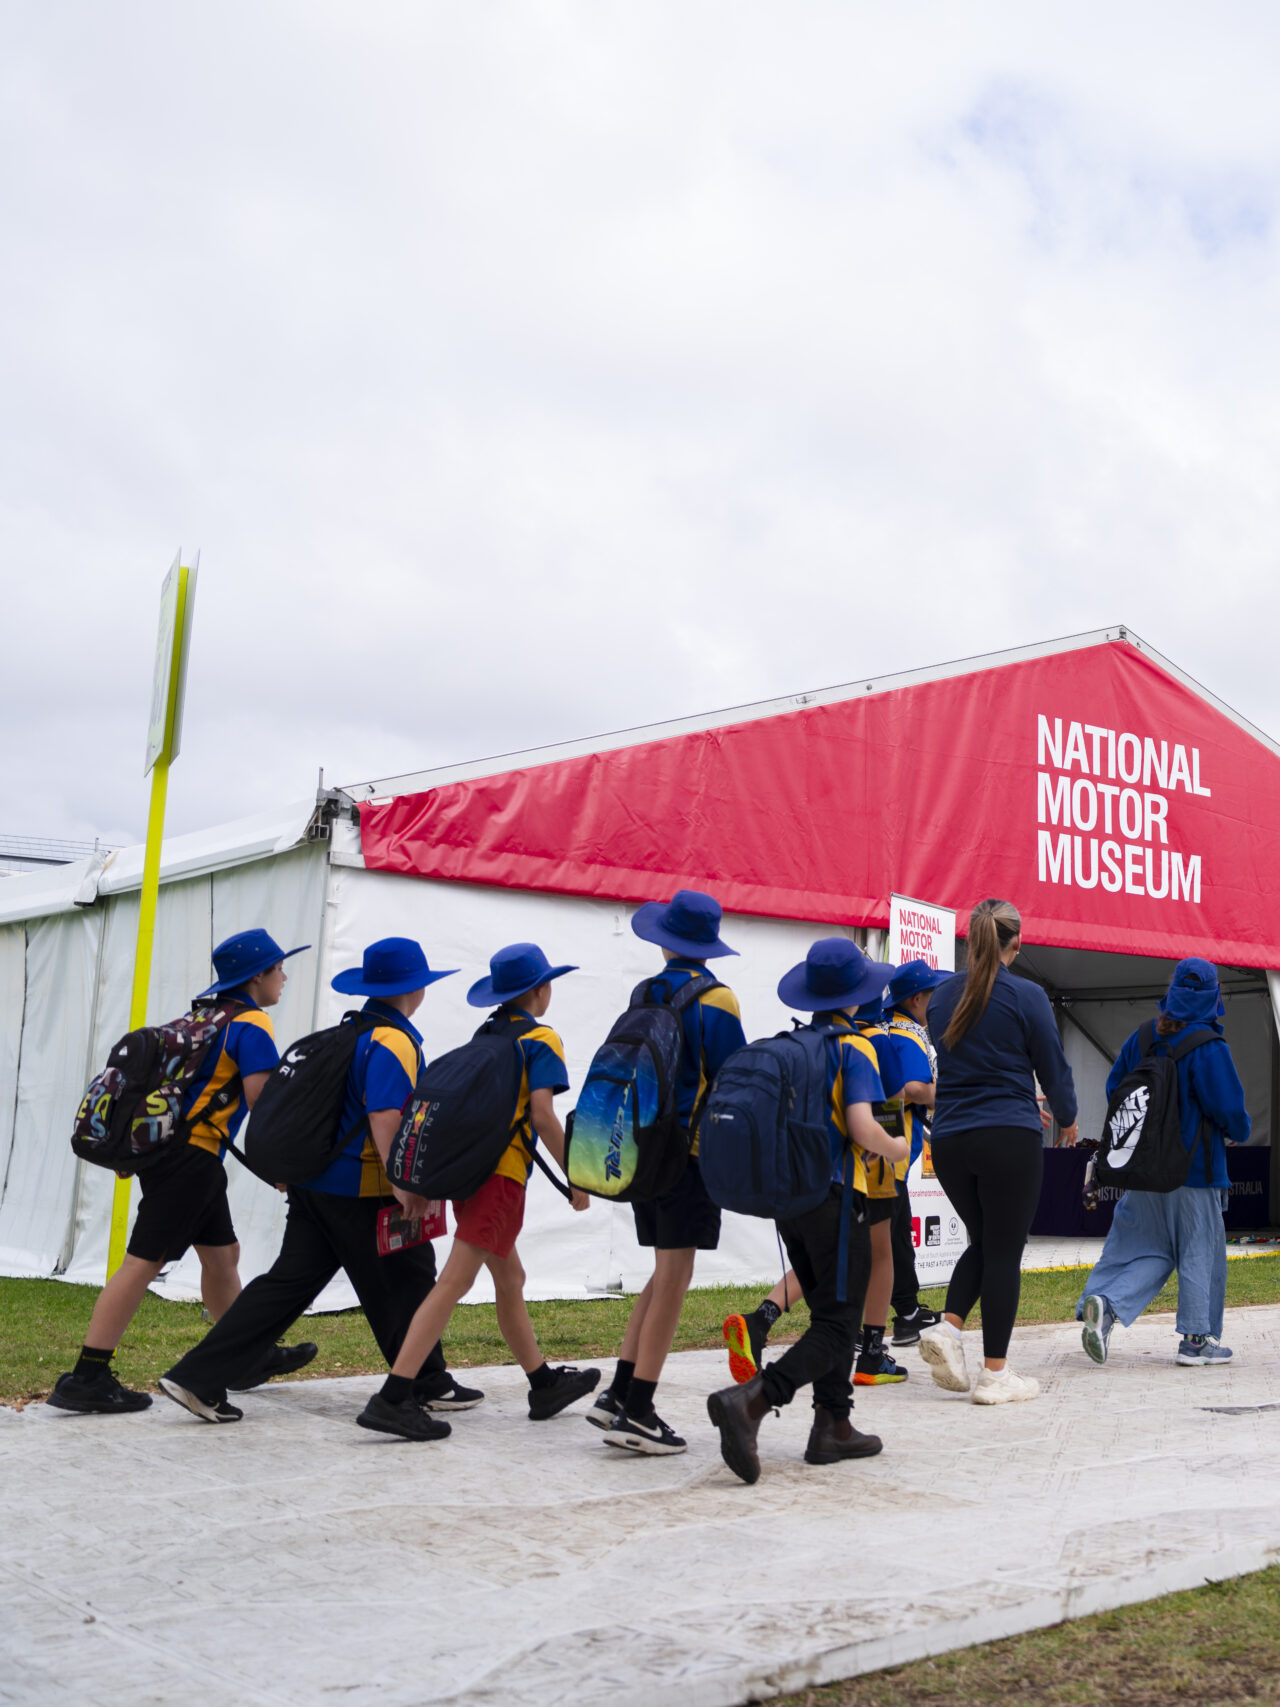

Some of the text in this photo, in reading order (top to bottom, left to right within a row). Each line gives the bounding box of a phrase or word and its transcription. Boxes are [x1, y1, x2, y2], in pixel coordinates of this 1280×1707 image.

[1037, 713, 1211, 797] NATIONAL
[1037, 771, 1168, 844] MOTOR
[1037, 829, 1201, 904] MUSEUM
[899, 908, 942, 935] NATIONAL
[900, 928, 933, 951] MOTOR
[394, 1100, 421, 1179] ORACLE
[411, 1102, 440, 1184] RACING
